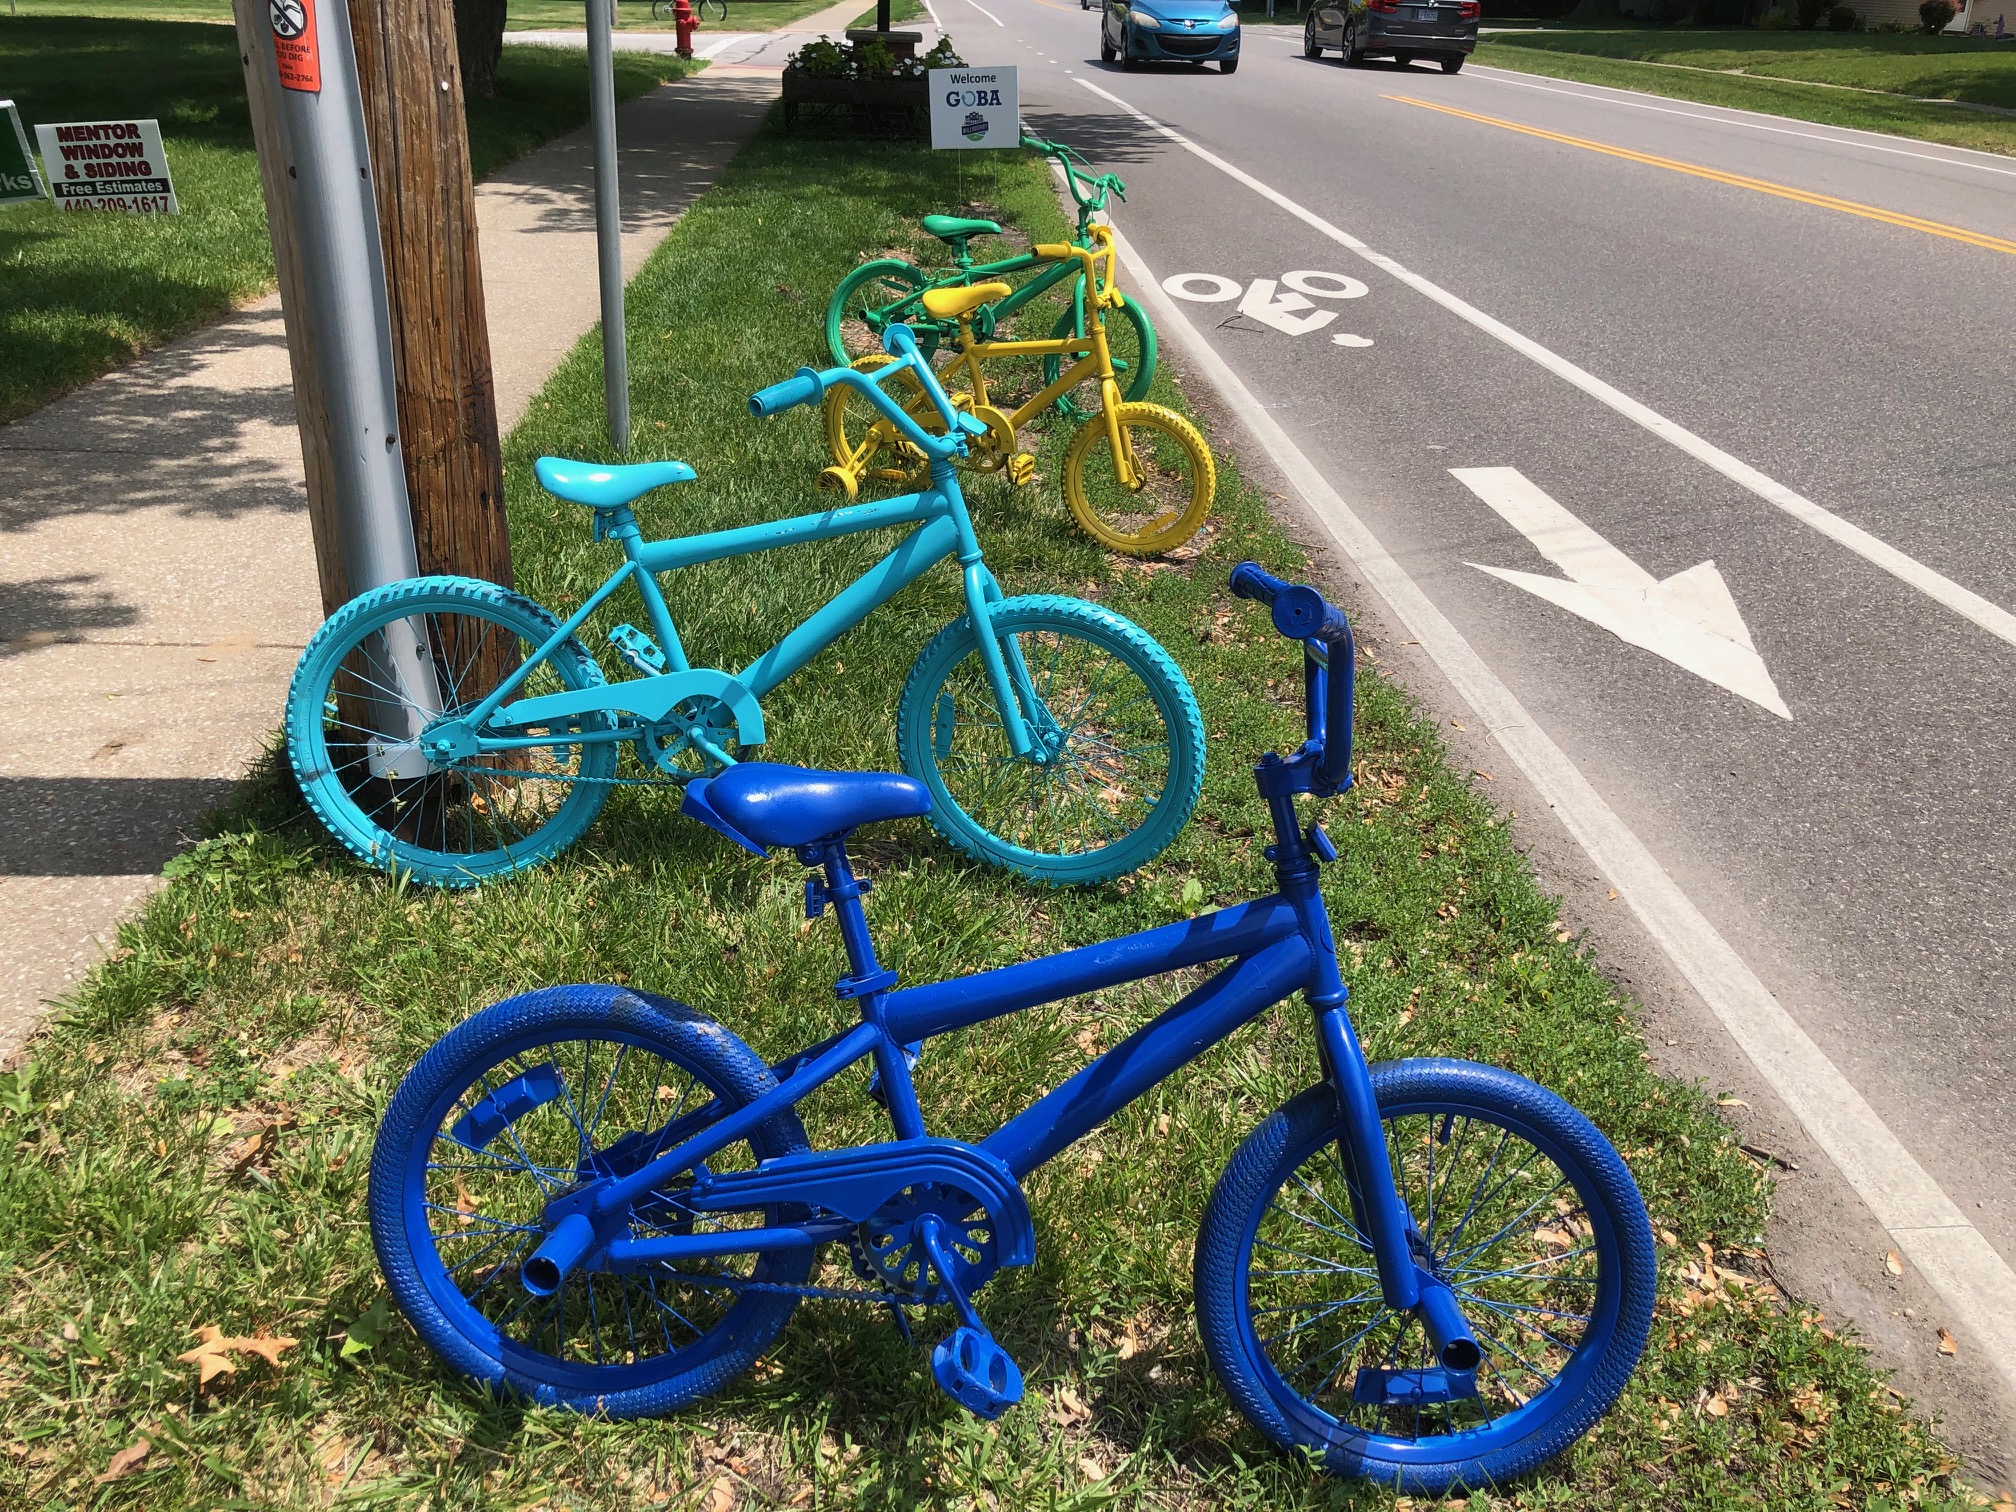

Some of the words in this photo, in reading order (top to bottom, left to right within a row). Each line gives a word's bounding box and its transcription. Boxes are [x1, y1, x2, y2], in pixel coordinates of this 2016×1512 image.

[282, 42, 311, 53] BEFORE
[288, 52, 304, 62] DIG
[950, 73, 997, 84] Welcome
[946, 90, 1002, 107] GOBA
[55, 123, 142, 142] MENTOR
[59, 142, 144, 161] WINDOW
[65, 164, 81, 180] &
[84, 160, 153, 179] SIDING
[0, 172, 33, 191] ks
[62, 183, 93, 195] Free
[96, 180, 163, 194] Estimates
